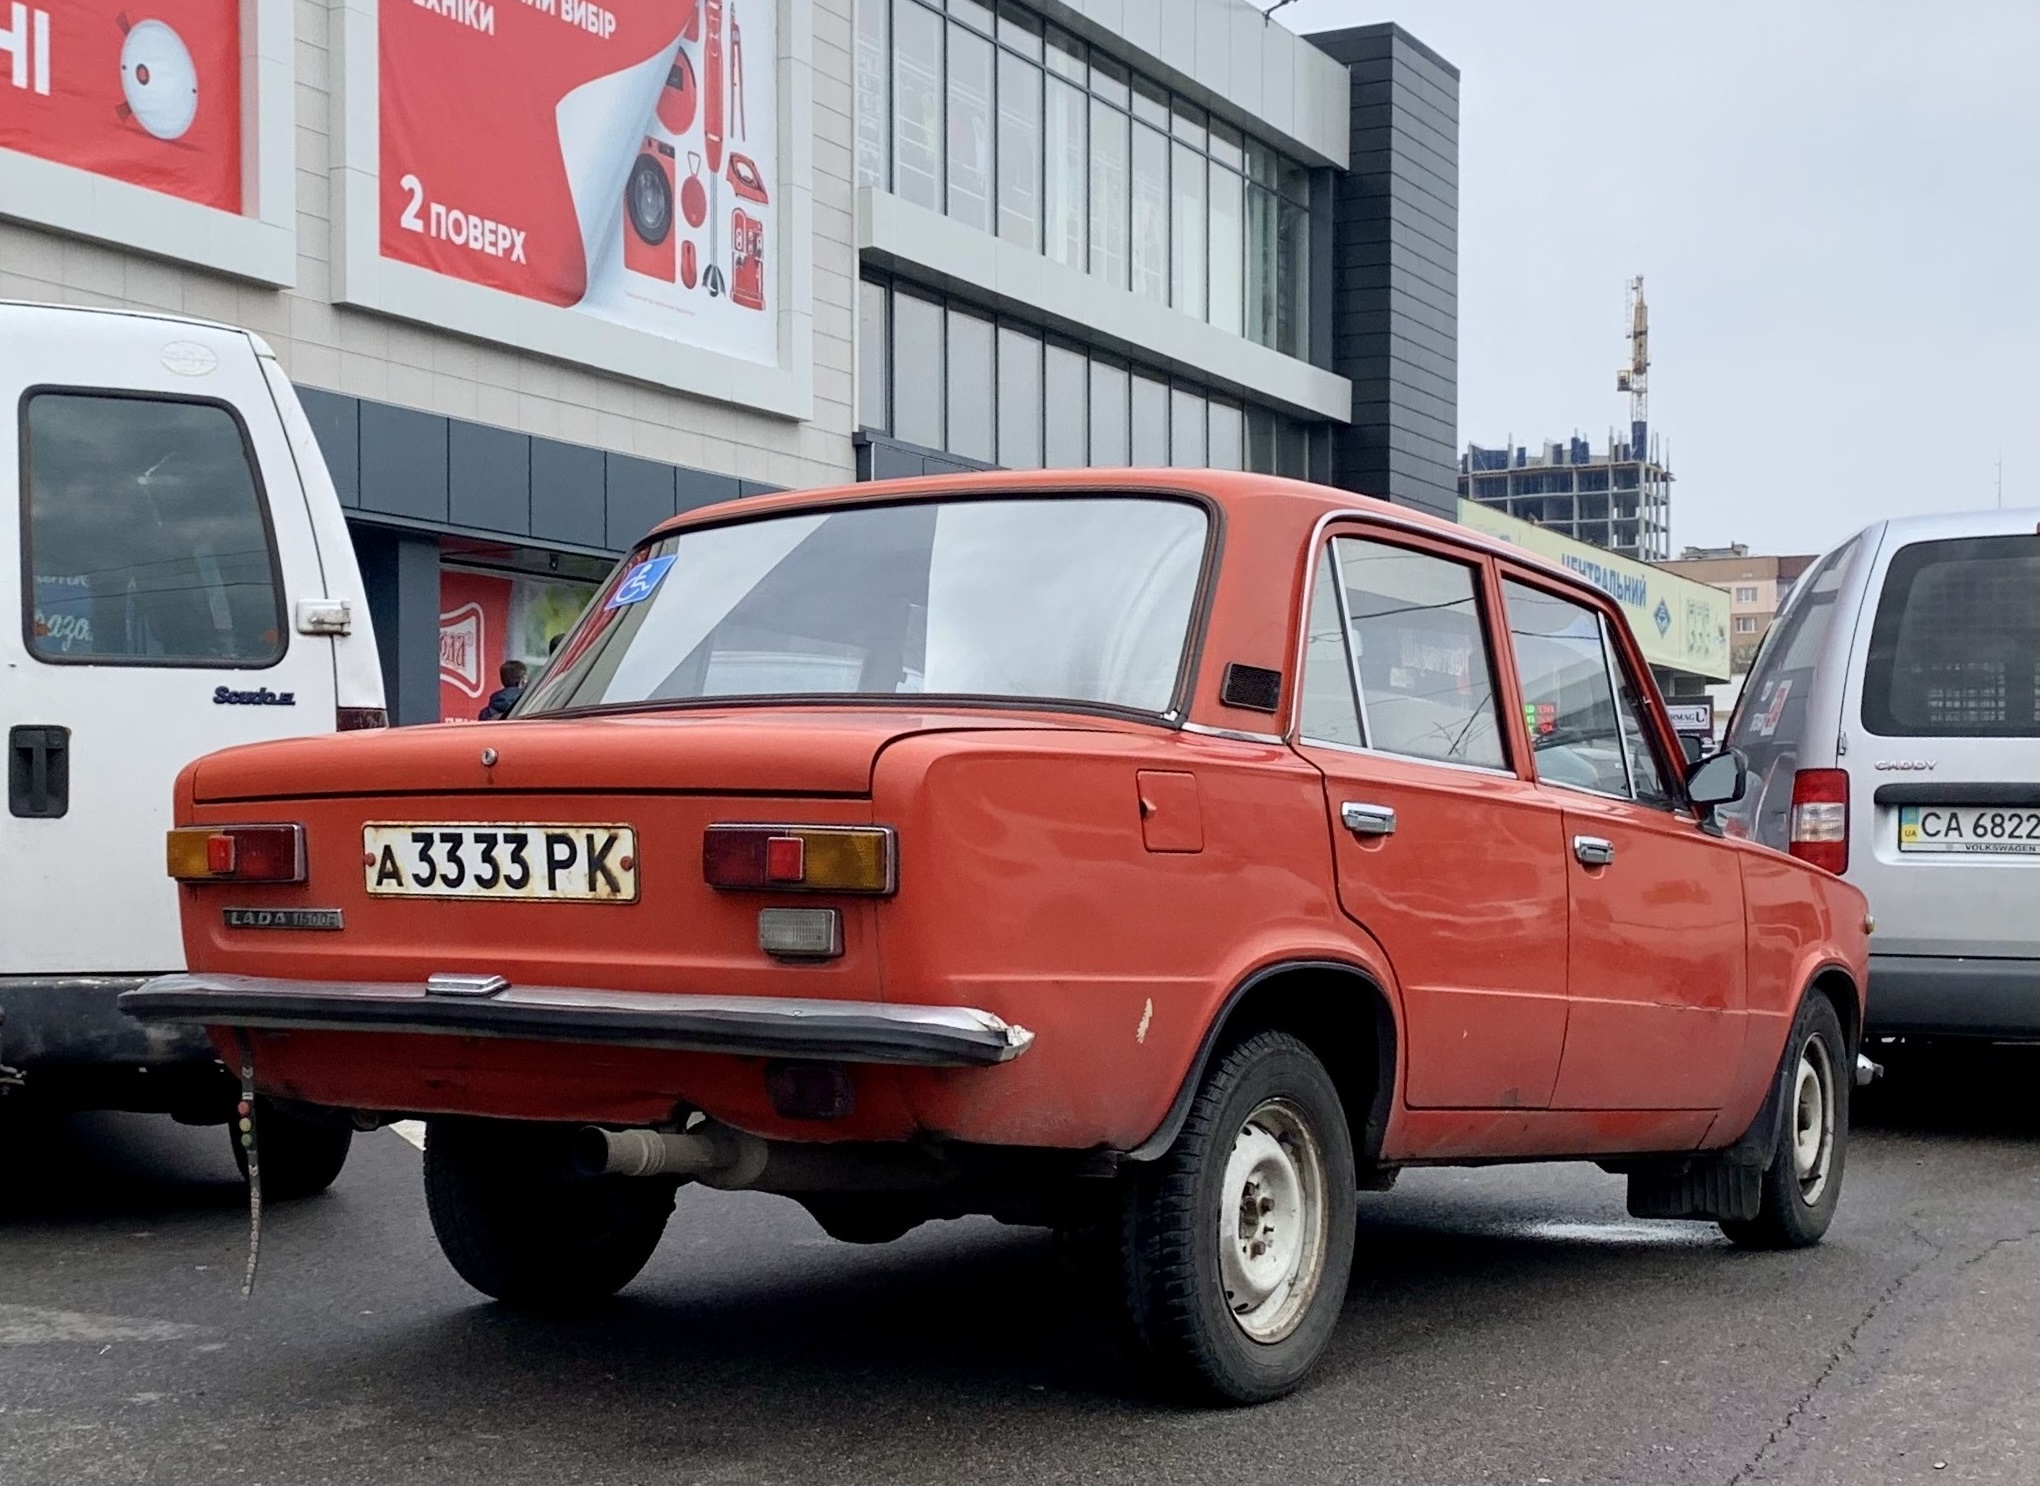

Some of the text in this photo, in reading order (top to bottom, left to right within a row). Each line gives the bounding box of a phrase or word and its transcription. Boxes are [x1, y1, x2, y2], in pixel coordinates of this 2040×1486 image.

[560, 0, 617, 39] ВИБІР
[400, 173, 527, 265] 2 ПОВЕРХ
[1874, 759, 1937, 771] CADDY
[1973, 812, 2040, 839] 6822
[1904, 829, 1917, 837] UA
[1965, 843, 2036, 852] VOLKSWAGEN
[231, 911, 287, 925] LADA
